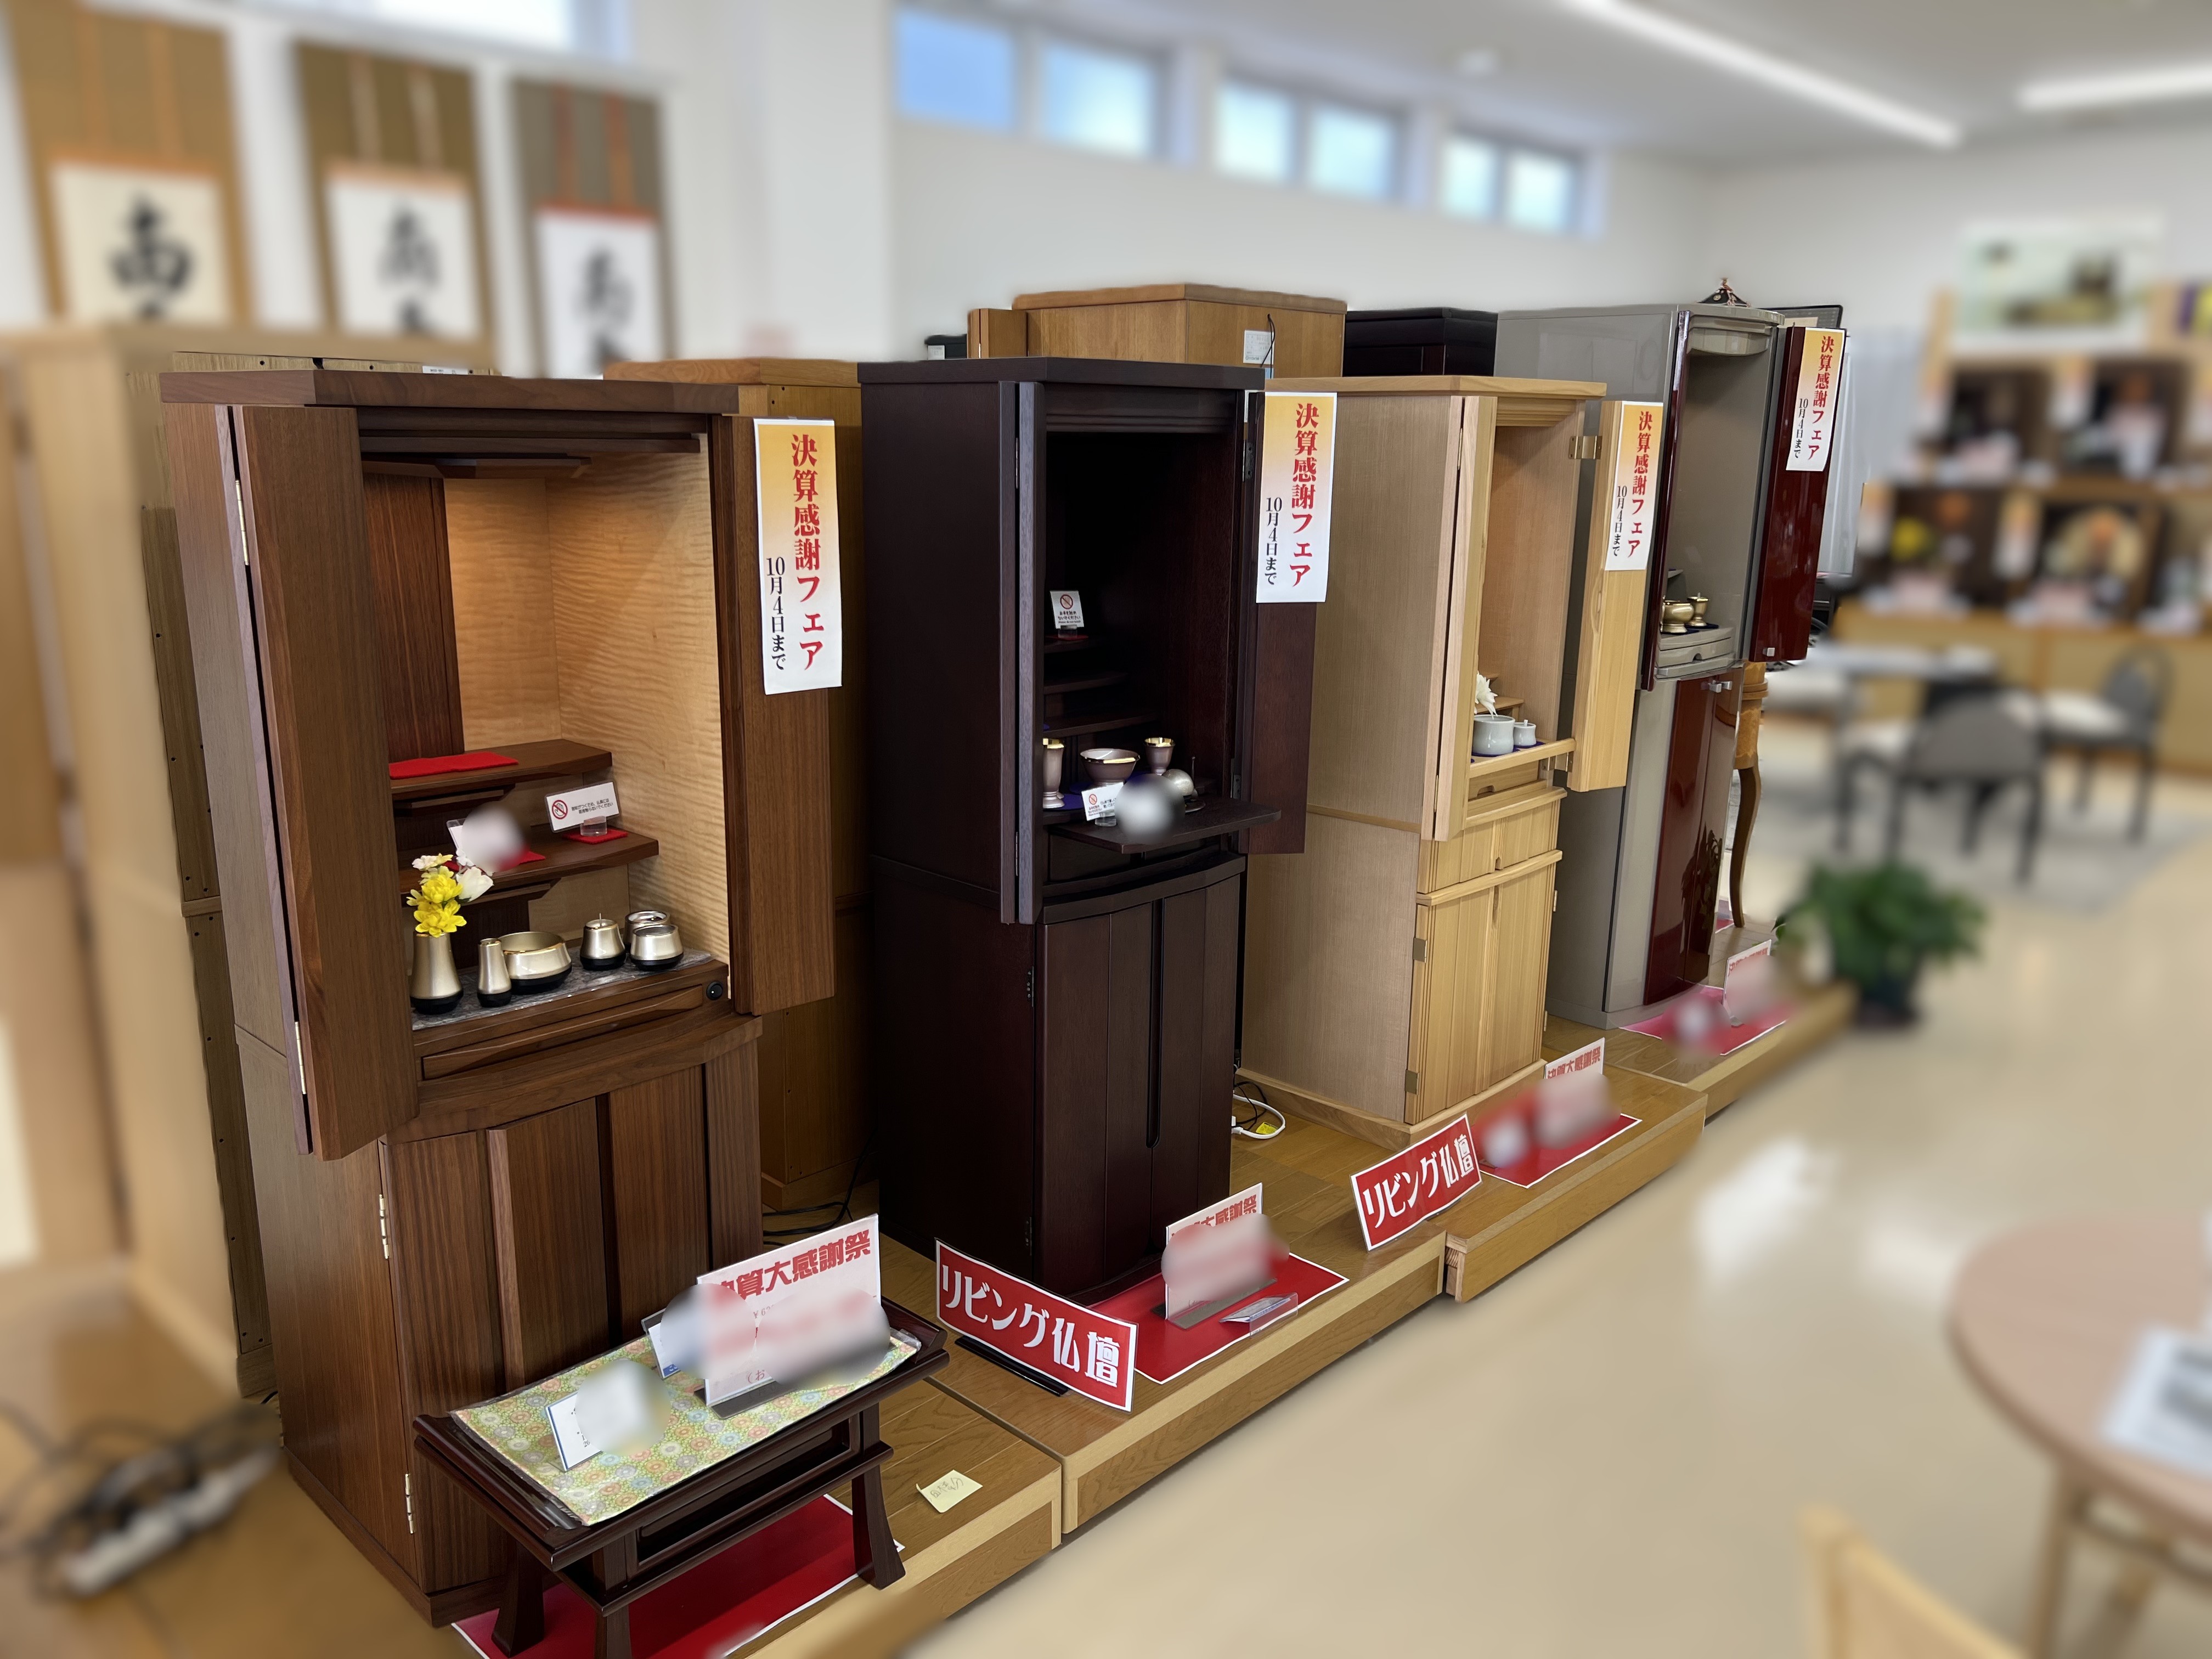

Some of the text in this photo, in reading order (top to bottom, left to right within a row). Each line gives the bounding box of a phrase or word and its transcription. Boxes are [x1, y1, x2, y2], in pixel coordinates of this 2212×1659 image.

[1793, 398, 1809, 459] 10月4日まで
[1808, 336, 1835, 460] 決算感謝フェア
[1265, 497, 1283, 585] 10月4日まで
[1290, 403, 1319, 587] 決算感謝フェア
[1612, 486, 1628, 557] 10月4日まで
[1628, 411, 1653, 558] 決算感謝フェア
[791, 433, 824, 671] 決算感謝フェア
[766, 556, 786, 671] 10月4日まで
[1362, 1133, 1475, 1228] リビング仏壇
[942, 1264, 1120, 1388] リビング仏壇
